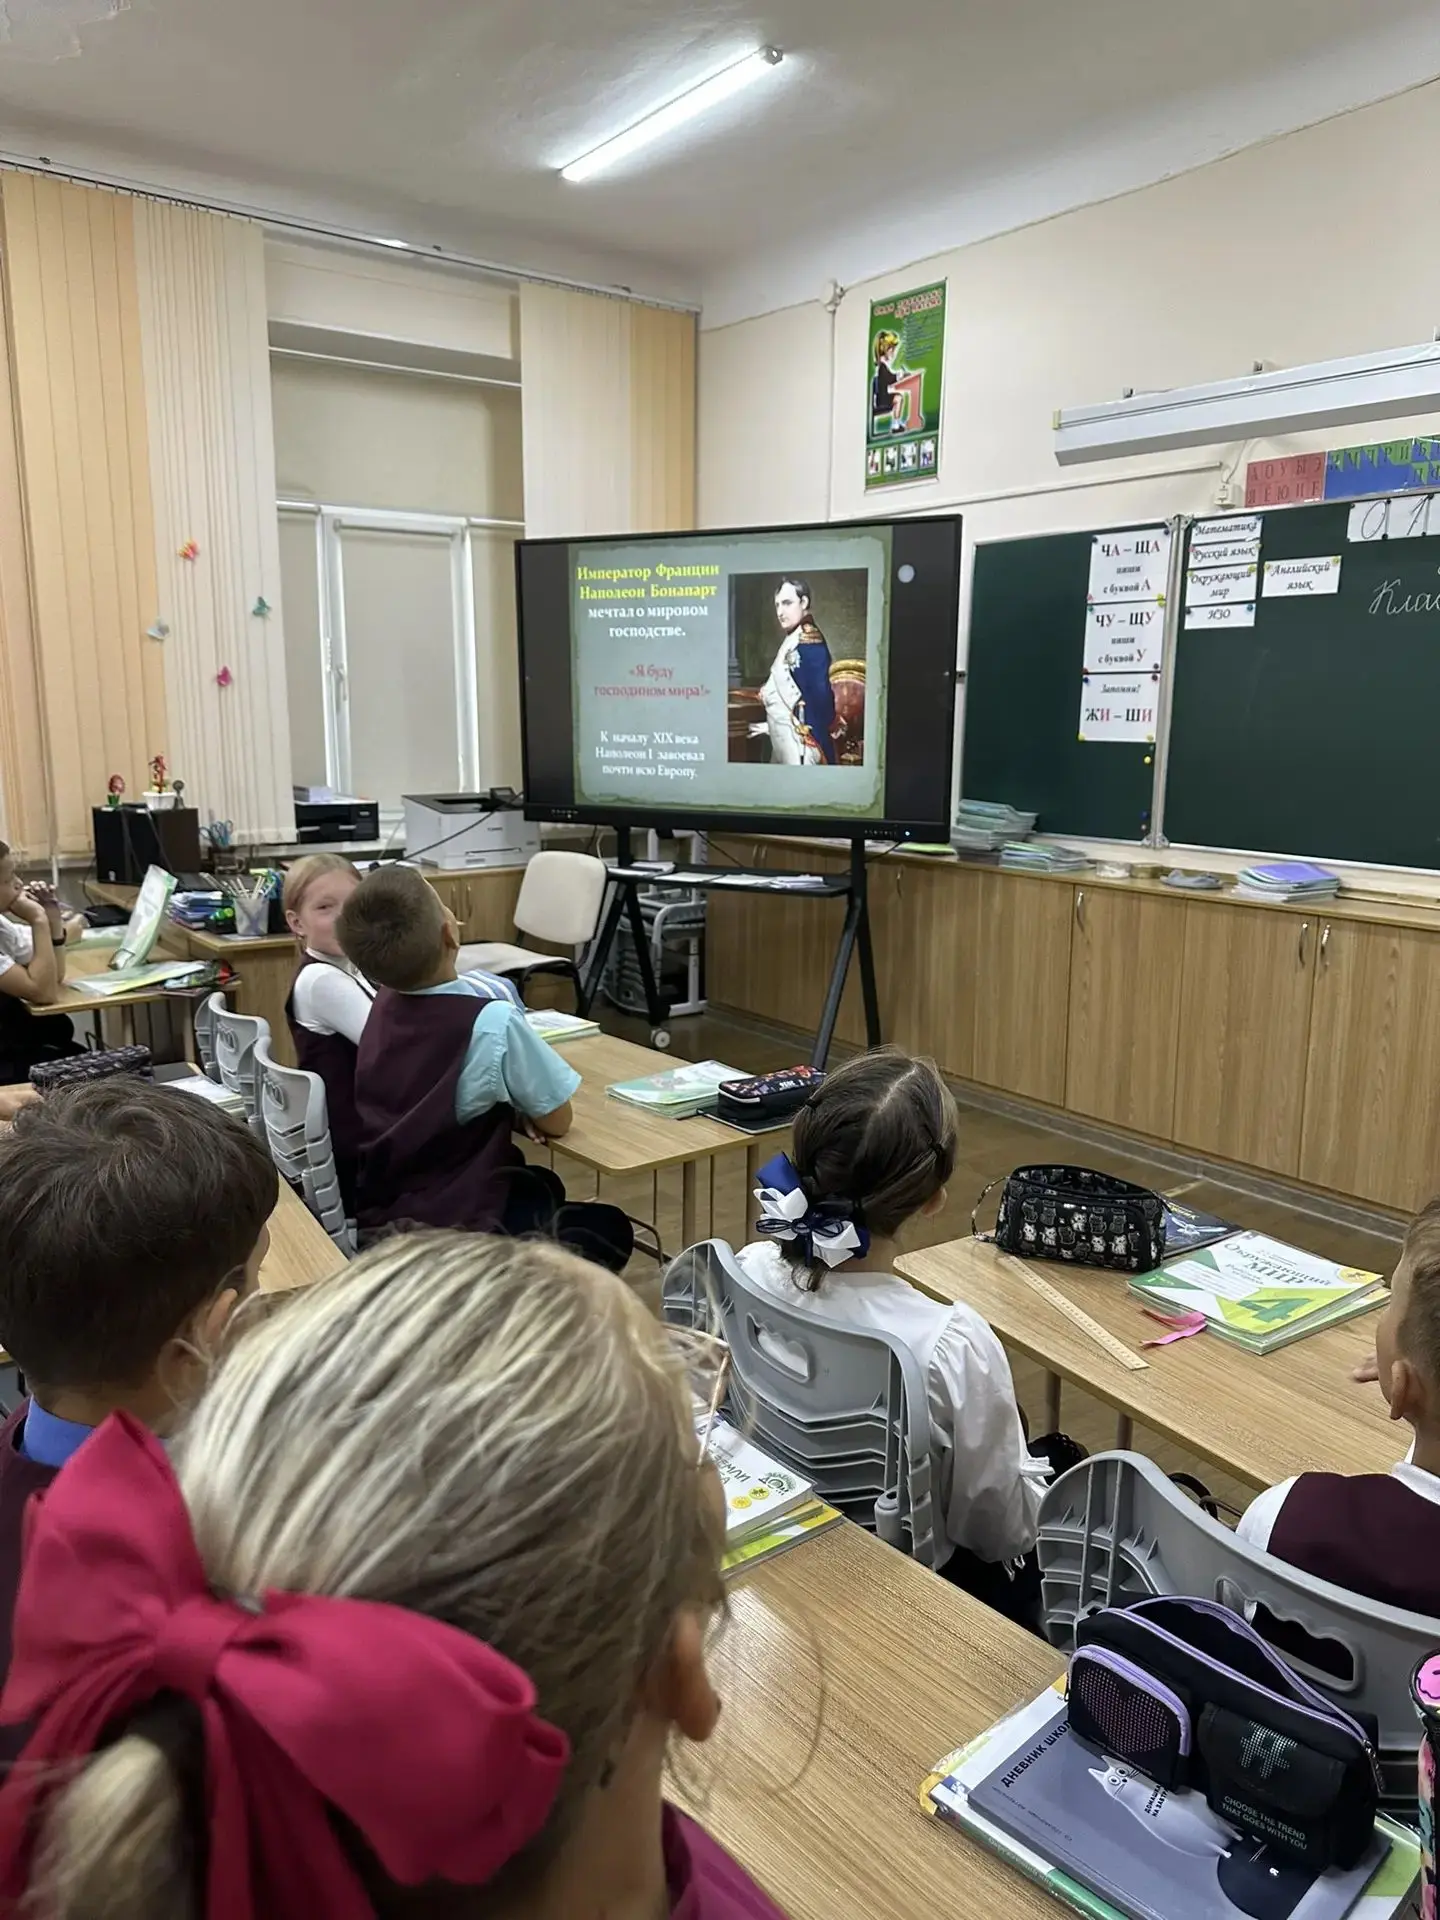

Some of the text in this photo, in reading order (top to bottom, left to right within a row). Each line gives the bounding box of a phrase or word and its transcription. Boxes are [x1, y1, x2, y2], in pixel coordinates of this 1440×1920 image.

[1195, 521, 1257, 536] Математика
[1101, 543, 1120, 557] ЧА
[1135, 540, 1161, 555] ЩА
[1193, 546, 1256, 562] Русский язык
[577, 563, 720, 582] Император Франции
[1116, 565, 1141, 574] пиши
[1271, 561, 1331, 577] Английский
[1191, 570, 1251, 586] Окружающий
[1287, 580, 1314, 591] язык
[580, 584, 717, 600] Наполеон Бонапарт
[1110, 582, 1140, 595] буквой
[1141, 578, 1151, 591] А
[1210, 588, 1230, 599] мир
[588, 604, 708, 620] мечтал о мировом
[1096, 614, 1116, 628] ЧУ
[1129, 611, 1155, 626] ЩУ
[1208, 608, 1231, 620] ИЗО
[608, 625, 686, 638] господстве.
[1111, 636, 1135, 645] пиши
[1104, 652, 1134, 665] буквой
[1137, 648, 1147, 662] У
[647, 663, 674, 681] буду
[594, 685, 666, 699] господином
[1085, 708, 1110, 722] ЖИ
[1125, 708, 1152, 722] ШИ
[600, 730, 699, 747] К началу XIX века
[595, 746, 646, 760] Наполеон
[657, 751, 705, 761] завоевал
[602, 765, 633, 775] почти
[636, 766, 655, 775] всю
[1224, 1242, 1331, 1286] Окружающий
[1001, 1744, 1048, 1788] ДНЕВНИК
[1224, 1795, 1306, 1840] CHOOSE THE TREND
[1222, 1803, 1308, 1850] THAT GOES WITH YOU
